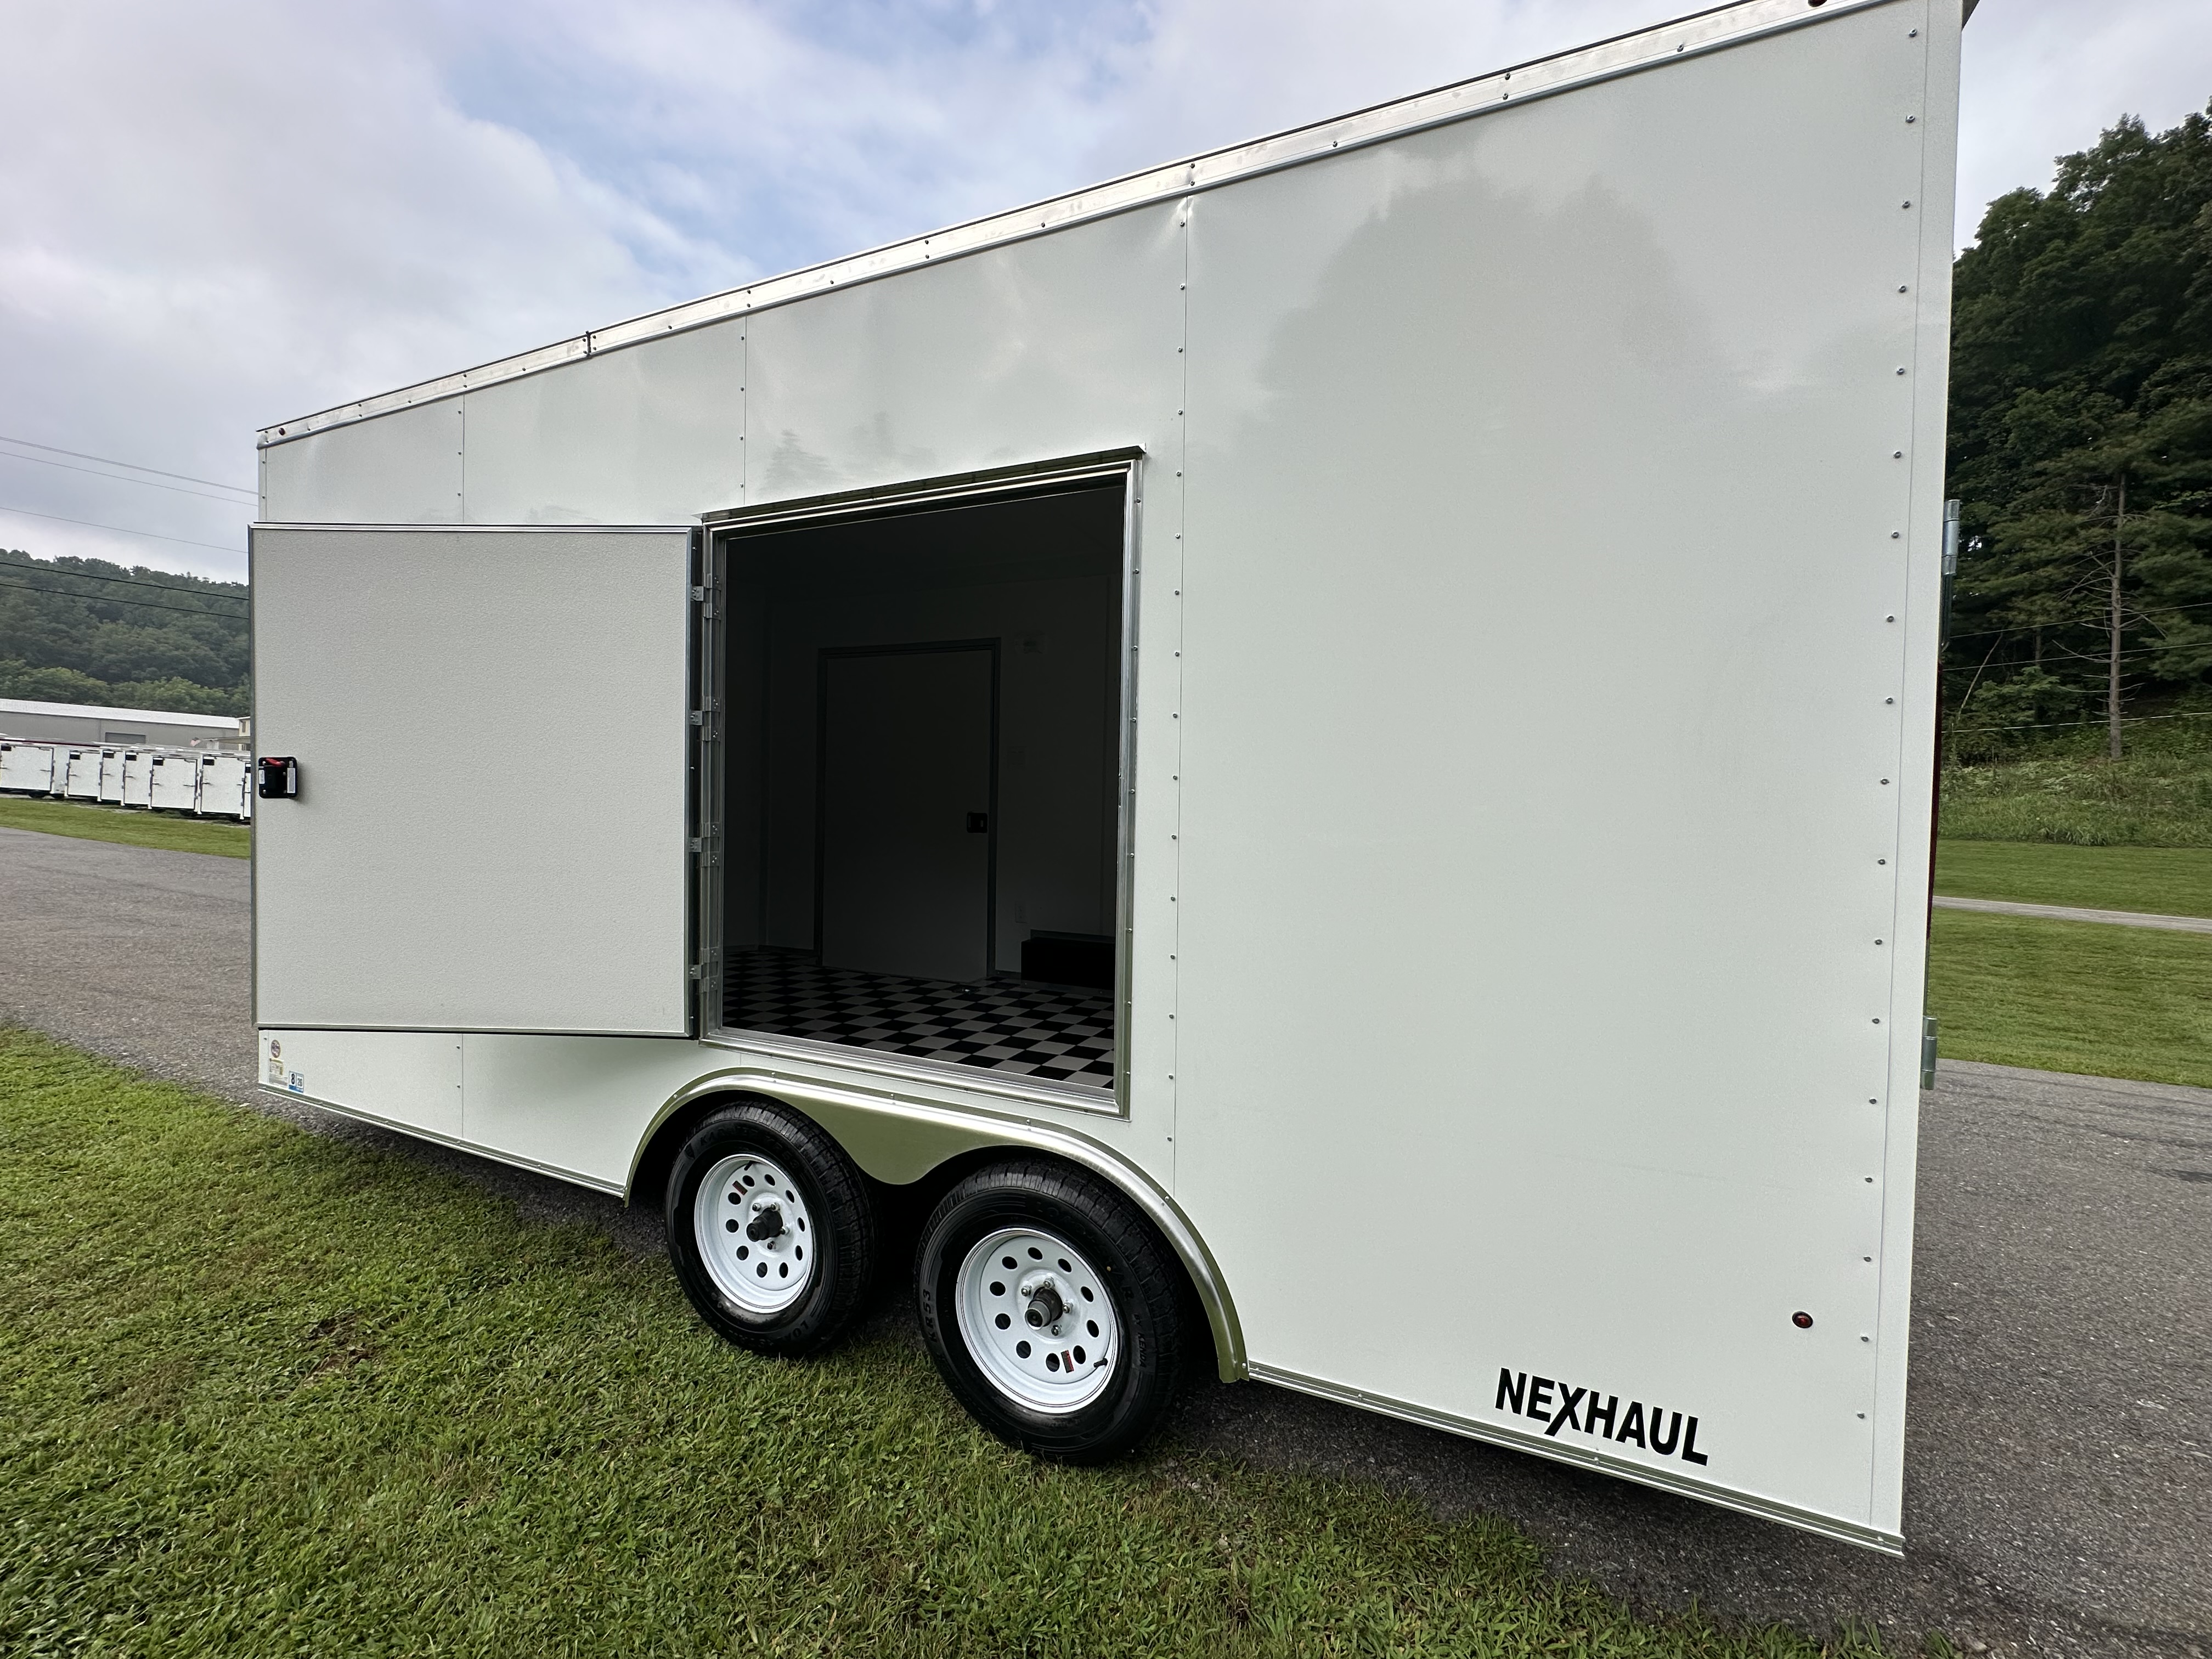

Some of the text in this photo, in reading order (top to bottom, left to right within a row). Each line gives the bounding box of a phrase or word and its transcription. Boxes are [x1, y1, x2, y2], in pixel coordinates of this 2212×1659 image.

[291, 1073, 295, 1085] 8
[923, 1289, 937, 1342] KR53
[1133, 1314, 1142, 1327] BY
[1138, 1332, 1147, 1368] KENDA
[1495, 1367, 1708, 1466] NEXHAUL
